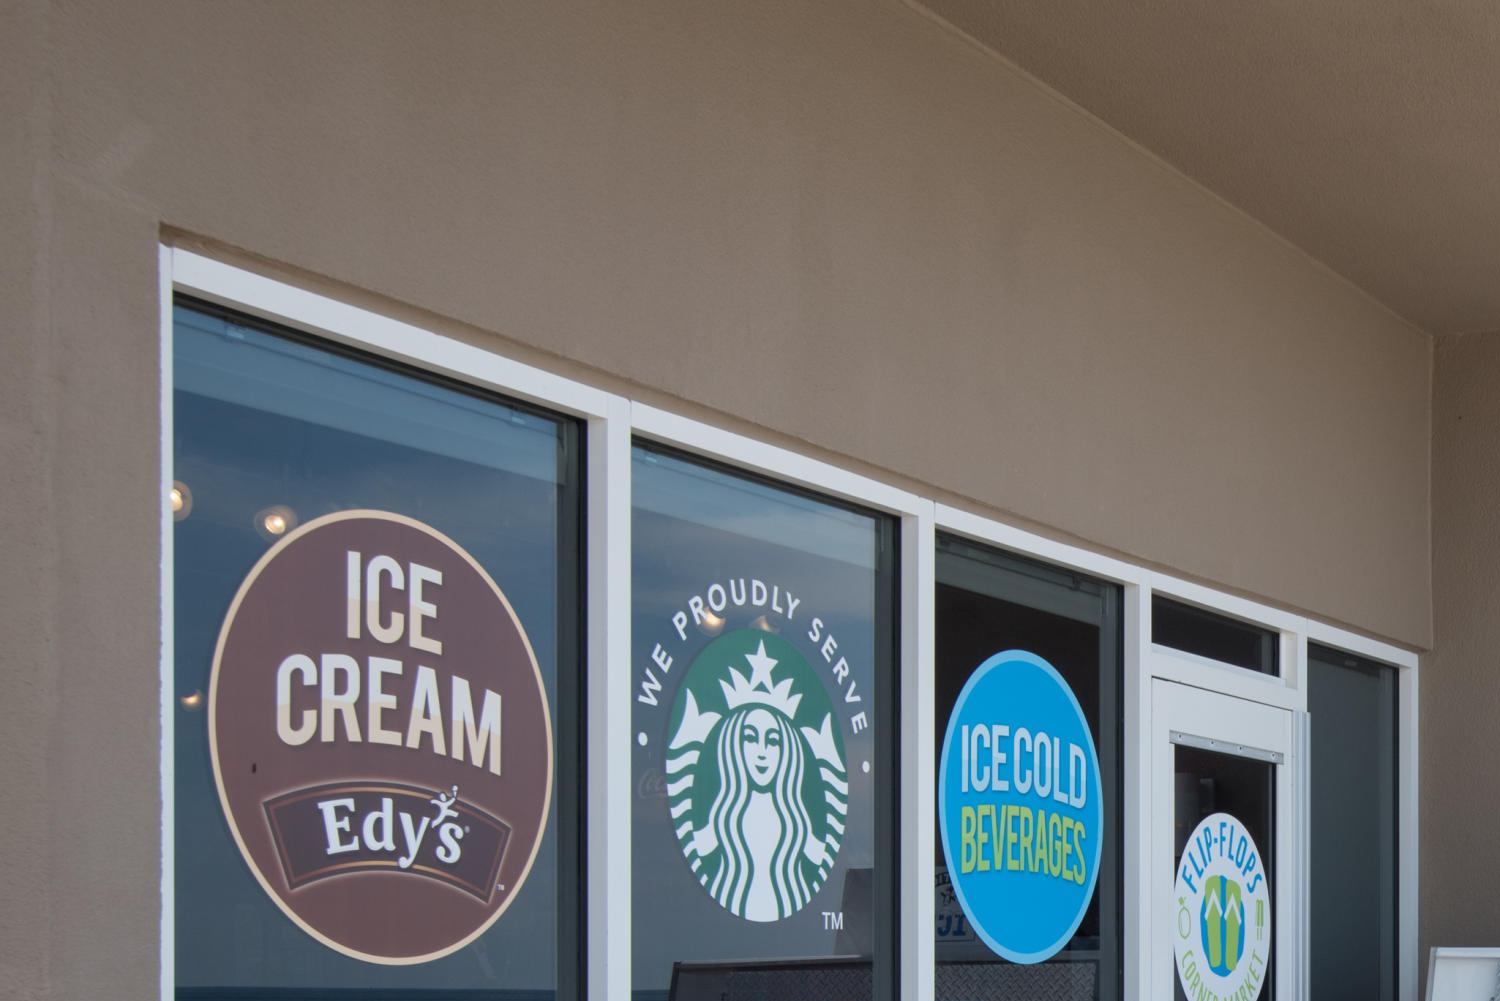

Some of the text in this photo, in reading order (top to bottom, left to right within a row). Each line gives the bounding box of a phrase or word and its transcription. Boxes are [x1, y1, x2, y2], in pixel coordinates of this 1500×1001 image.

[347, 550, 442, 655] ICE
[638, 578, 868, 734] WE PROUDLY SERVE
[276, 653, 501, 776] CREAM
[962, 724, 1087, 809] ICE COLD
[318, 796, 464, 868] Edy's
[961, 804, 1087, 886] BEVERAGES
[1182, 821, 1262, 894] FLIP-FLOPS
[821, 911, 844, 931] TM
